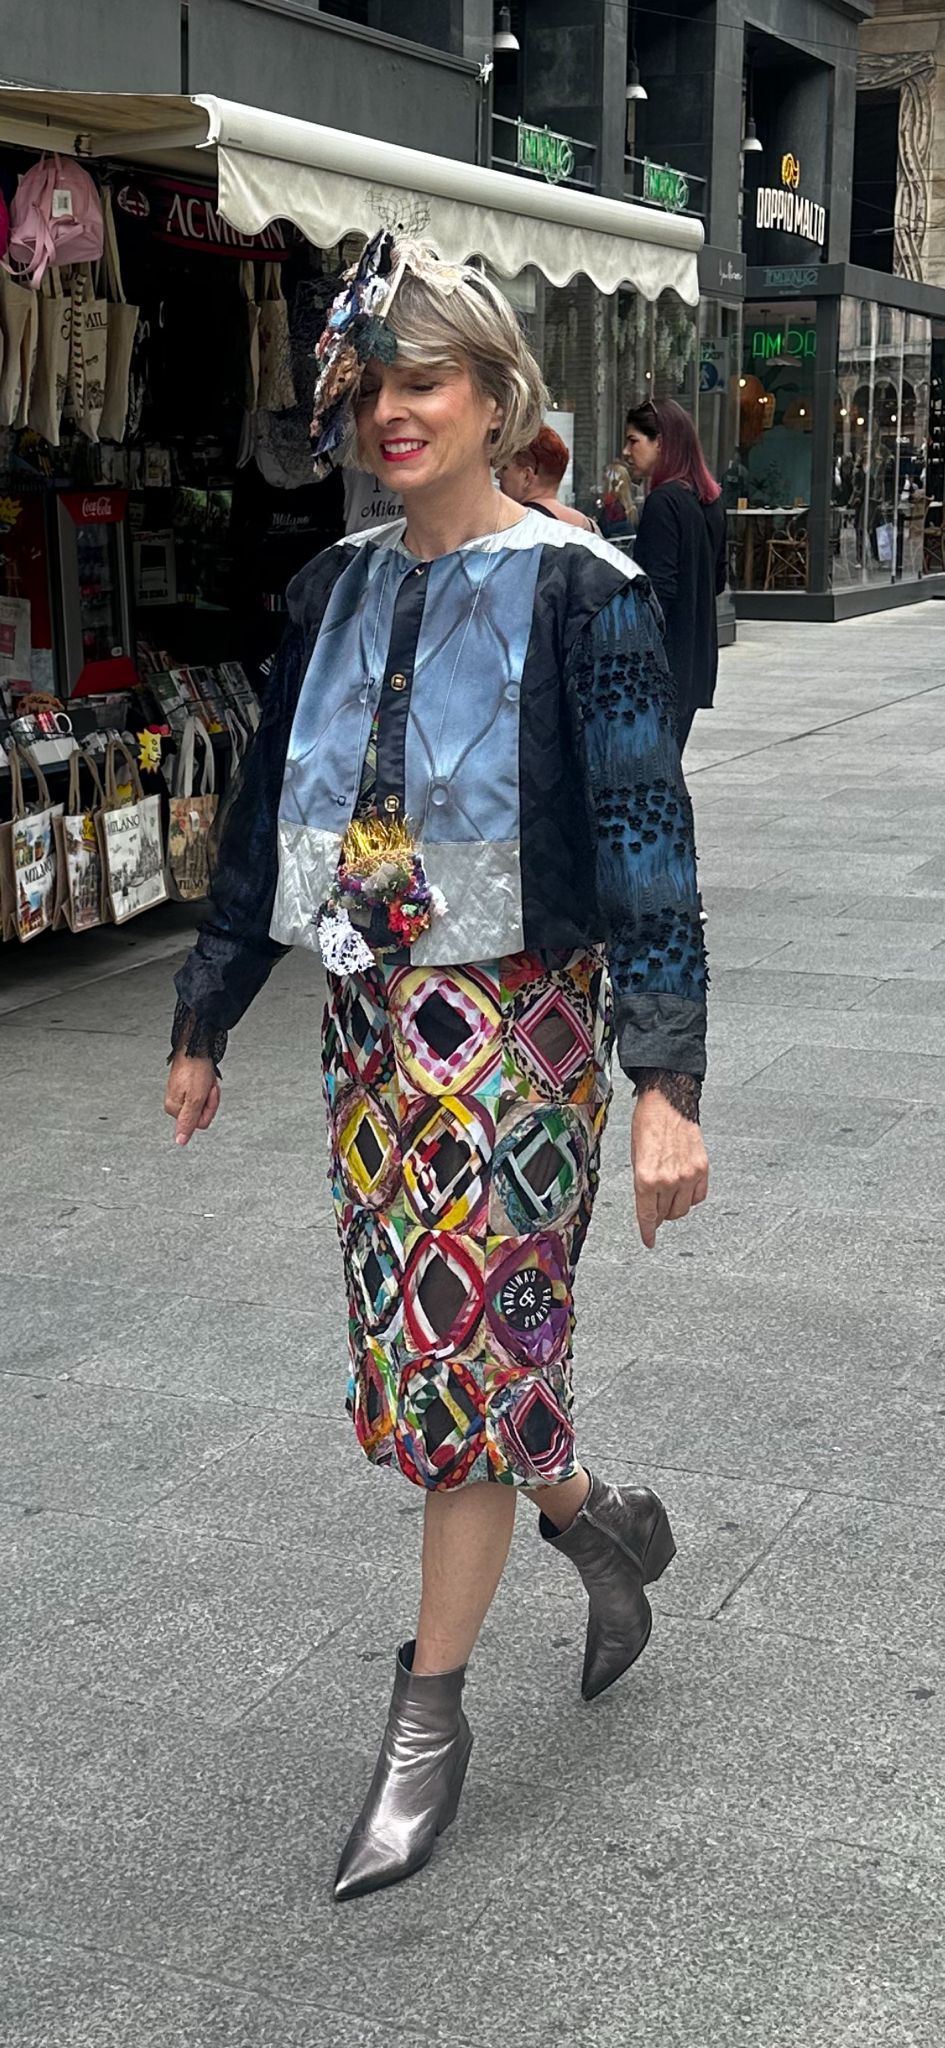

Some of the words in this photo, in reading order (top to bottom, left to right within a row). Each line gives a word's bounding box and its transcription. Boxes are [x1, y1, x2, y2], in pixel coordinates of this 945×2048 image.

[756, 187, 795, 233] DOPPIO
[794, 194, 826, 246] MALTO
[360, 500, 405, 518] Milan
[107, 814, 140, 836] MILANO
[503, 1270, 537, 1315] PAULINA'S
[524, 1287, 552, 1328] FRIENDS
